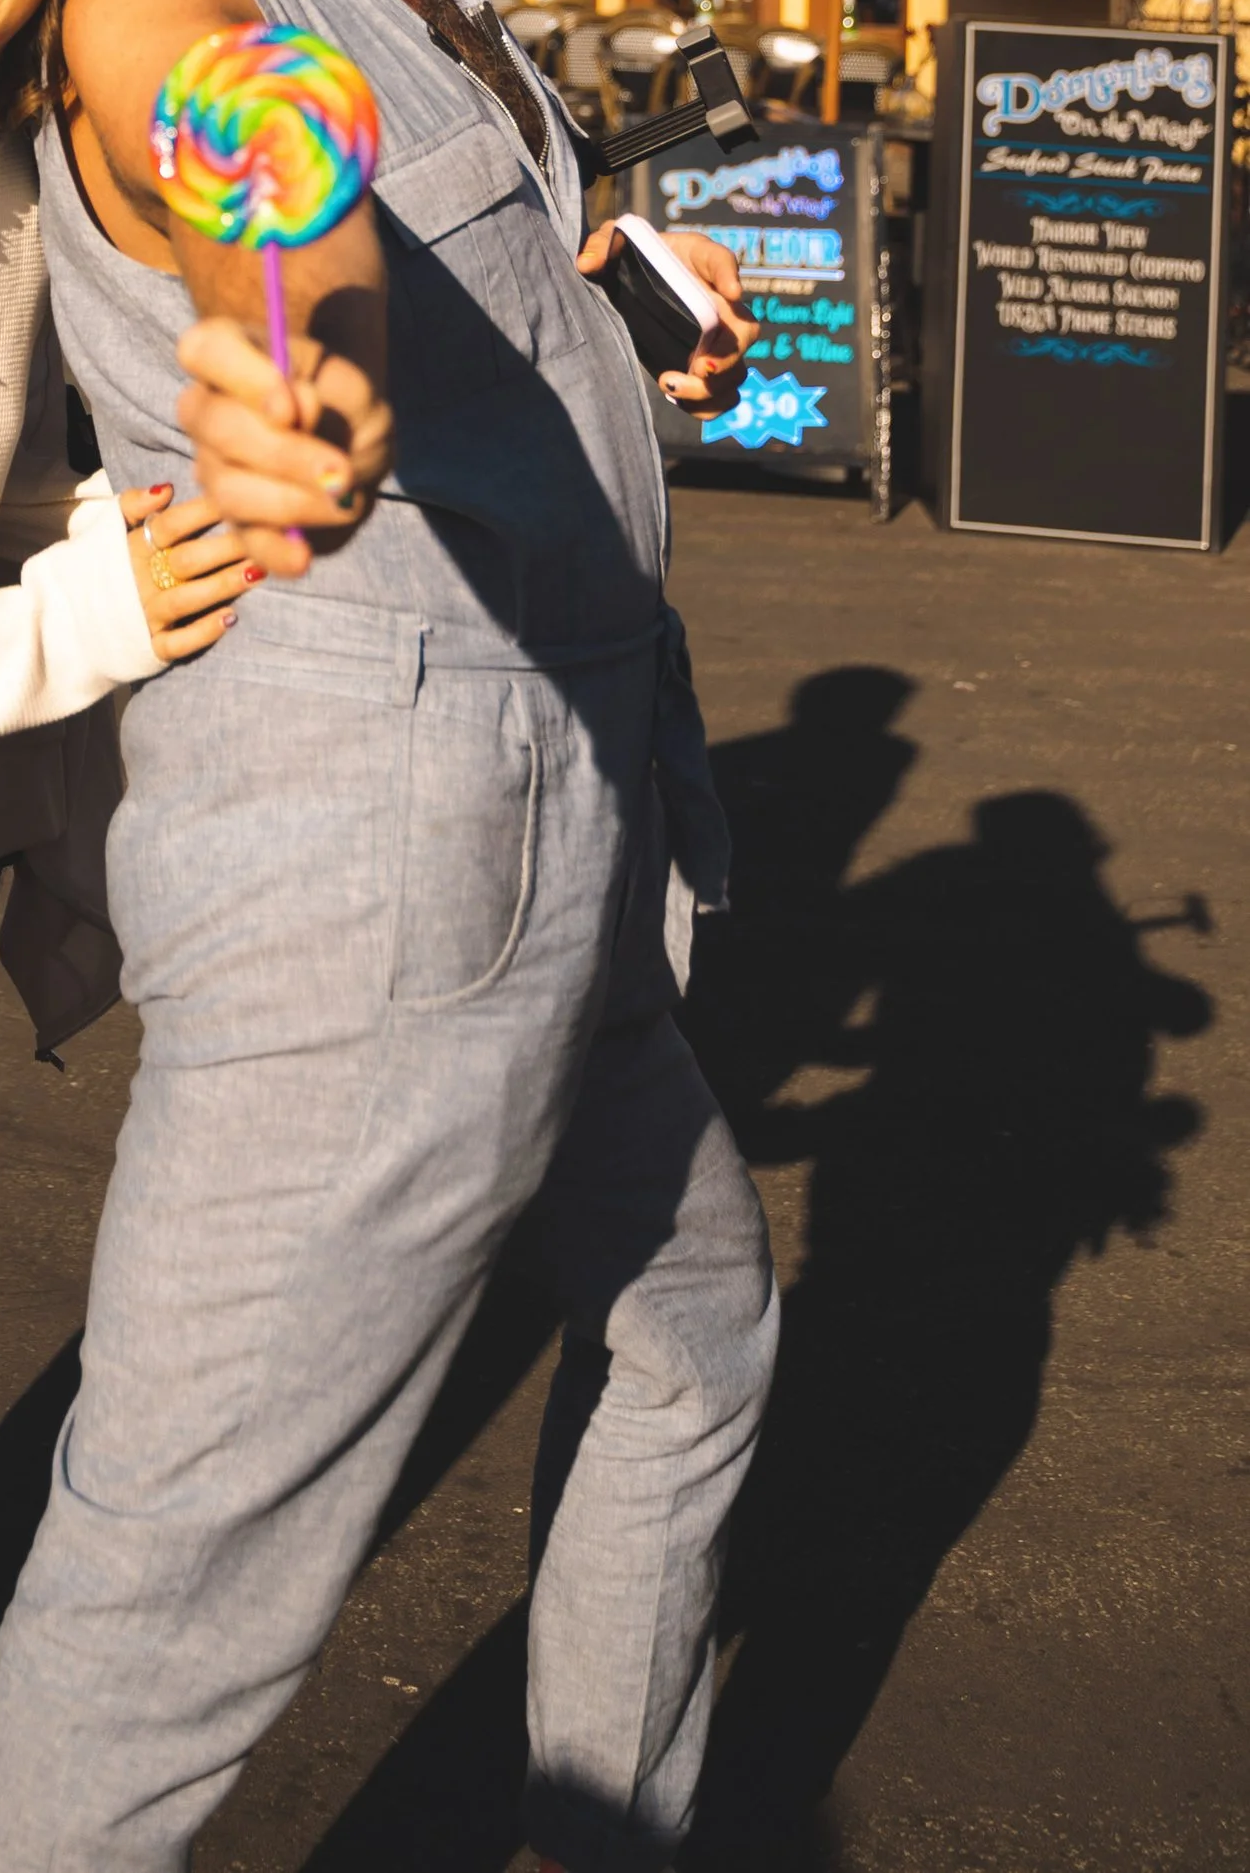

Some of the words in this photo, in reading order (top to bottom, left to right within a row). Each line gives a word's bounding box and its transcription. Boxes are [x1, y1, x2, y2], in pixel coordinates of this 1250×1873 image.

[1053, 109, 1101, 138] On
[1126, 109, 1212, 151] Wharf
[981, 146, 1070, 177] Seafood
[1068, 152, 1139, 178] Steak
[1139, 156, 1202, 185] Pasta
[776, 192, 837, 220] Wharf
[762, 227, 844, 268] HOUR
[1101, 220, 1149, 250] VIEW
[973, 239, 1035, 270] WORLD
[1035, 244, 1128, 276] RENOWNED
[1129, 251, 1206, 283] CIOPPINO
[997, 270, 1044, 299] WILD
[1112, 279, 1180, 310] SALMON
[811, 297, 855, 333] Light
[995, 300, 1057, 333] USDA
[1058, 305, 1113, 335] PRIME
[1115, 309, 1177, 339] STEAKS
[773, 332, 793, 360] &
[796, 333, 854, 363] Wine
